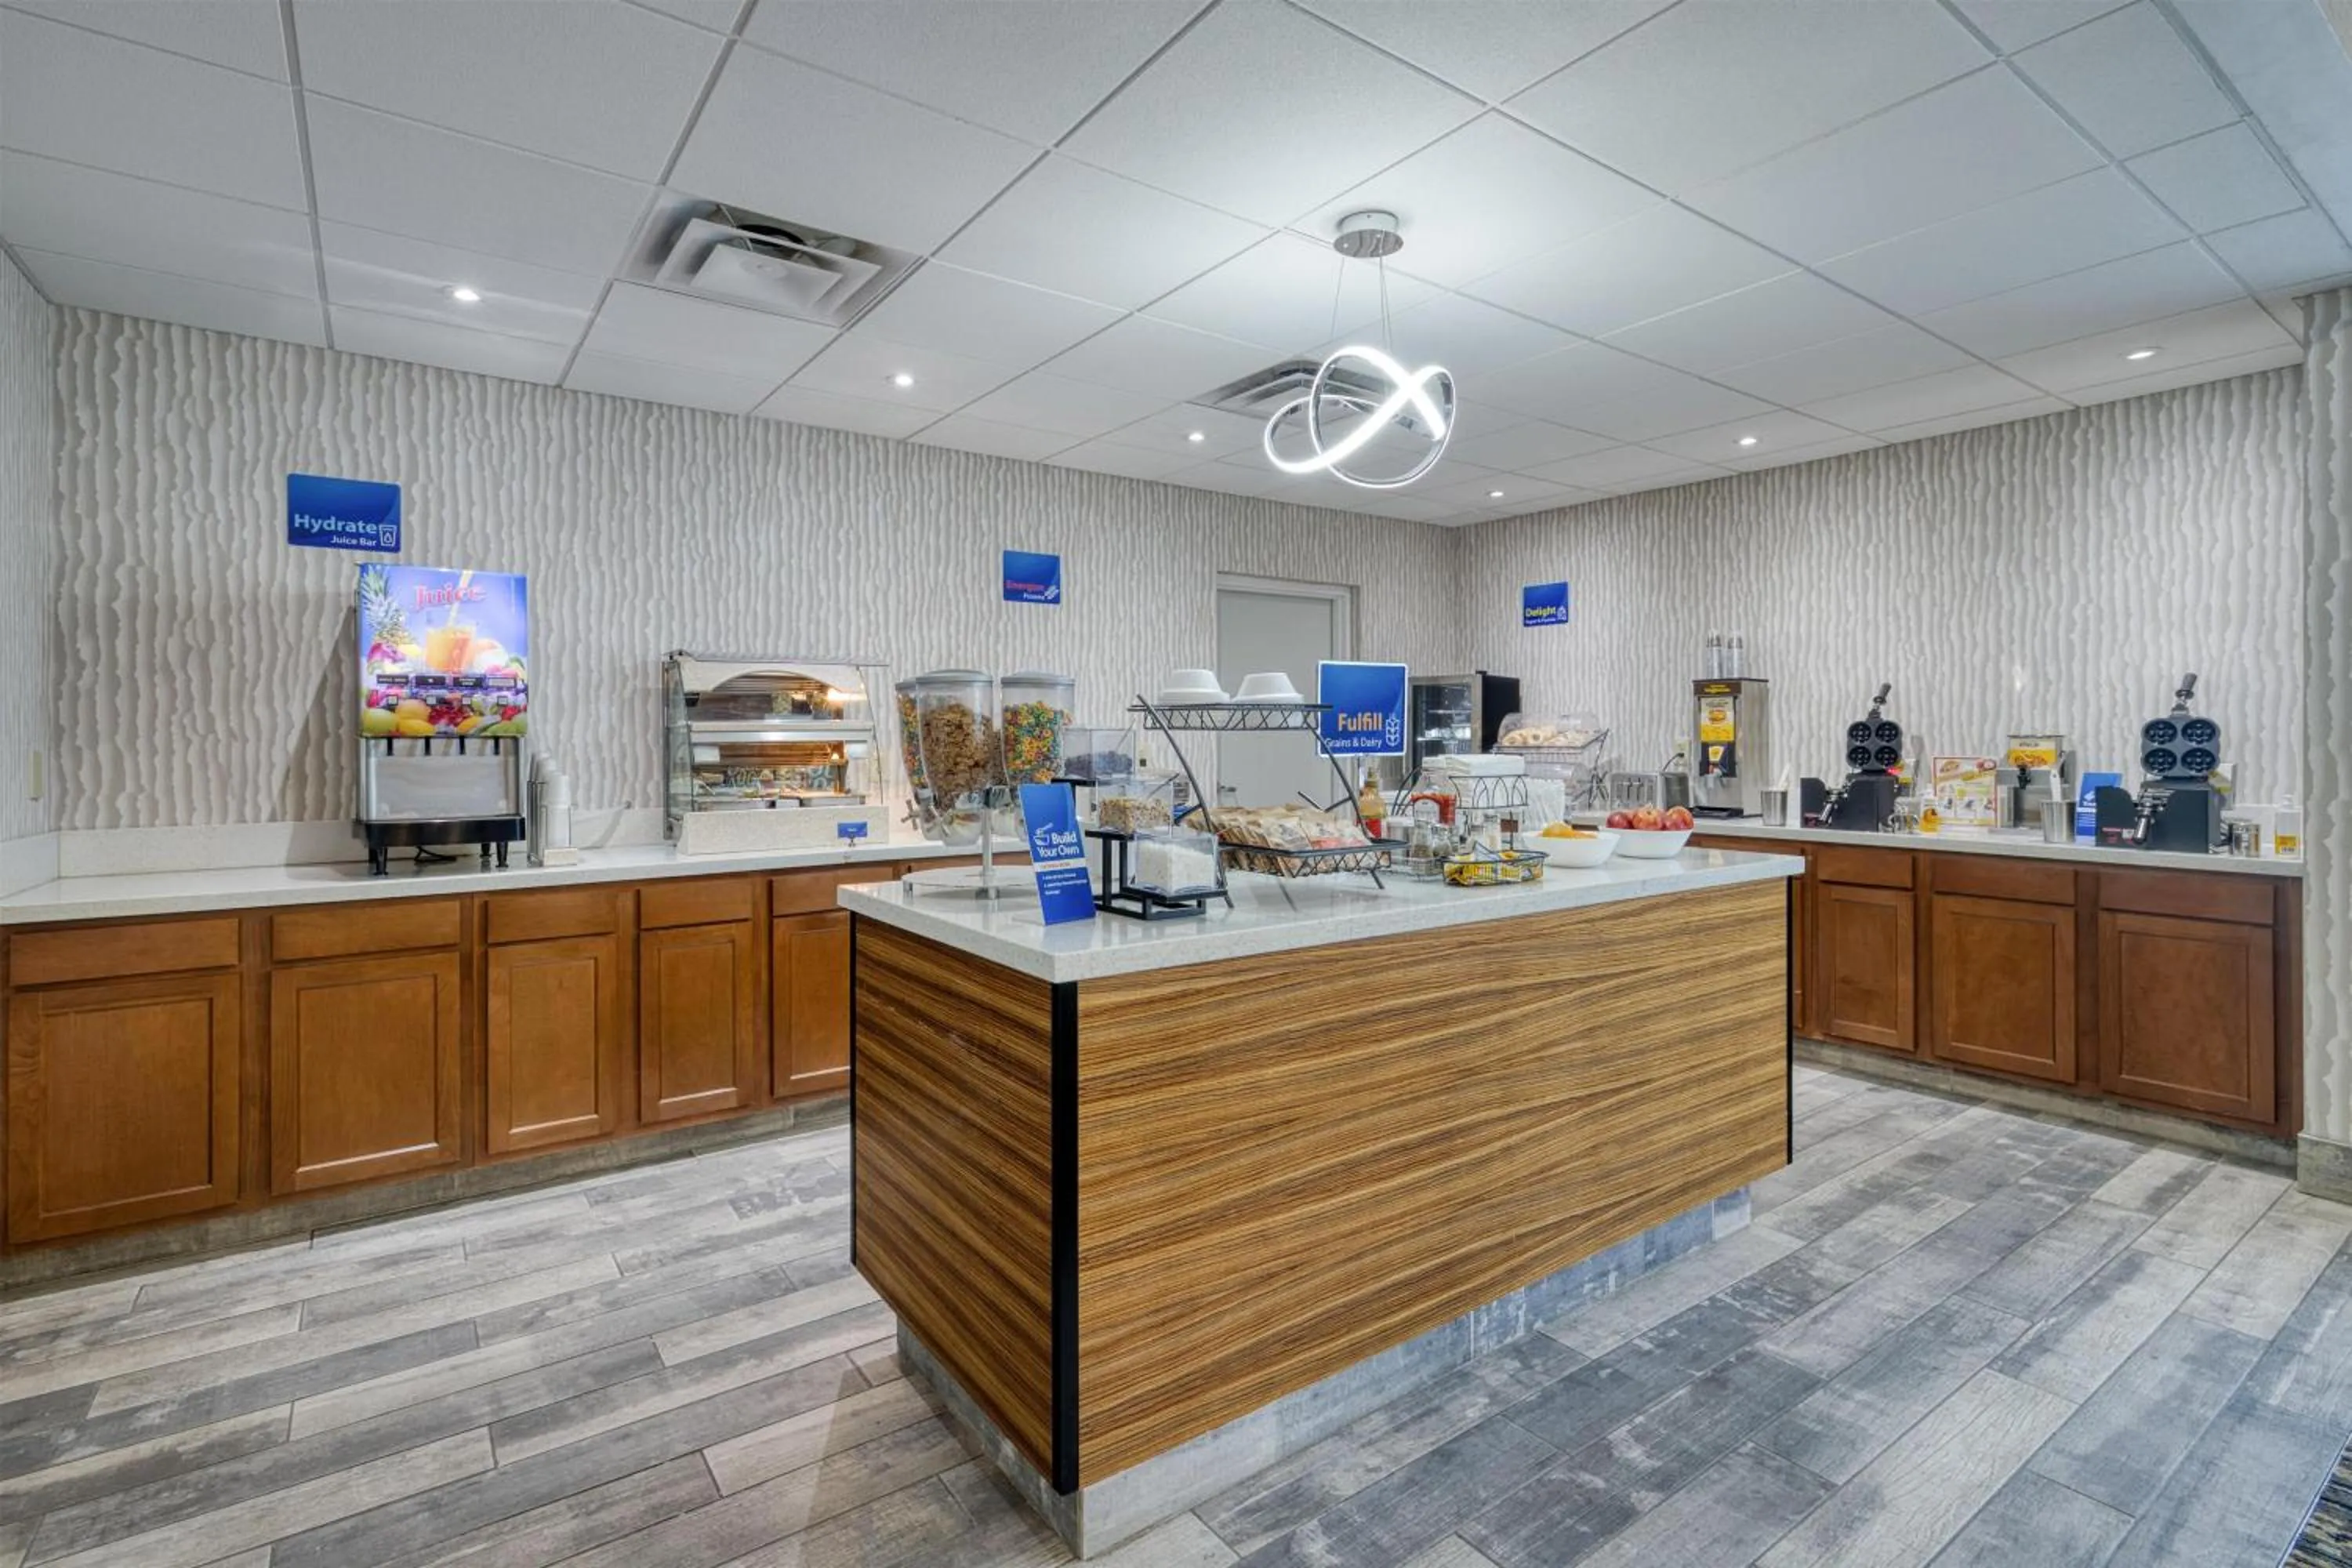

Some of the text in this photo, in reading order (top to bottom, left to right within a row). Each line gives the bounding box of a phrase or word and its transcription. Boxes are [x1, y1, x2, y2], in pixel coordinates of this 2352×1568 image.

[294, 514, 377, 534] Hydrate
[330, 535, 376, 546] Juice Bar
[1338, 712, 1382, 731] Fulfill
[1360, 737, 1382, 748] Dairy
[1051, 830, 1078, 845] Build
[1036, 844, 1080, 858] Your Own
